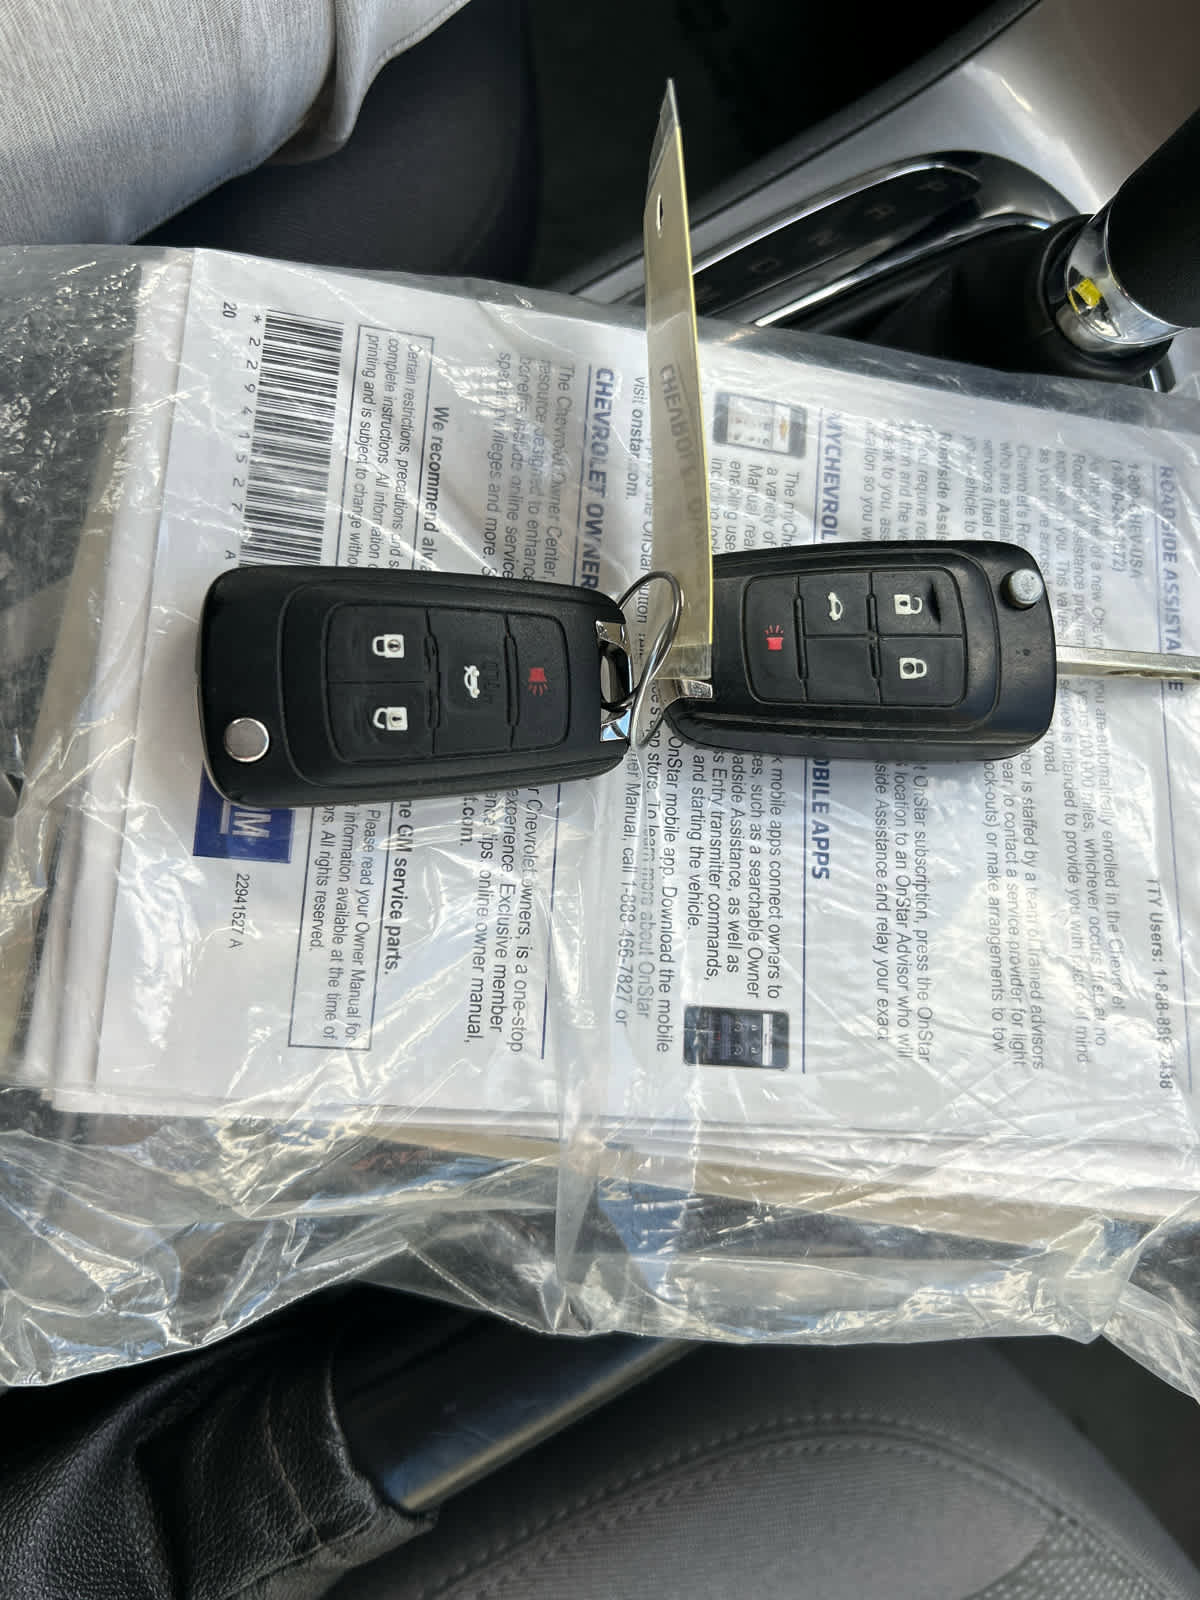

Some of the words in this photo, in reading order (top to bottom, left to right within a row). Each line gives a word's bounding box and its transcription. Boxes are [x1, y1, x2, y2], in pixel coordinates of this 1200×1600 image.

[222, 301, 237, 318] 20
[363, 334, 379, 378] printing
[384, 338, 399, 393] complete
[558, 363, 575, 391] The
[362, 381, 375, 404] and
[633, 377, 645, 404] visit
[361, 408, 373, 417] is
[398, 387, 415, 455] restrictions,
[432, 406, 449, 431] We
[588, 368, 614, 497] CHEVROLET
[355, 421, 369, 464] subject
[355, 468, 367, 479] to
[376, 472, 389, 488] All
[391, 459, 409, 530] precautions
[423, 436, 444, 531] recommend
[785, 471, 799, 497] The
[349, 483, 368, 528] change
[487, 483, 501, 512] and
[528, 501, 540, 515] to
[898, 502, 912, 522] the
[1159, 466, 1178, 563] ROADSIDE
[368, 491, 386, 558] information
[482, 517, 497, 559] more.
[764, 531, 776, 545] of
[1161, 568, 1184, 691] ASSISTAE
[646, 753, 661, 793] store.
[667, 736, 684, 787] OnStar
[692, 756, 707, 782] and
[1044, 741, 1059, 775] road.
[709, 768, 726, 806] Entry
[749, 785, 764, 818] such
[769, 768, 784, 816] mobile
[895, 771, 909, 826] location
[913, 776, 928, 826] OnStar
[1021, 782, 1034, 792] is
[363, 810, 380, 852] Please
[621, 783, 641, 841] Manual,
[647, 802, 661, 820] To
[664, 794, 681, 842] mobile
[686, 787, 706, 840] starting
[750, 823, 762, 840] as
[1022, 798, 1036, 845] staffed
[1065, 813, 1078, 826] to
[320, 831, 335, 846] All
[339, 812, 360, 882] information
[395, 824, 412, 852] GM
[689, 846, 703, 868] the
[709, 810, 724, 889] transmitter
[727, 808, 745, 891] Assistance,
[749, 845, 760, 854] a
[767, 820, 782, 855] apps
[811, 820, 830, 879] APPS
[875, 800, 890, 878] Assistance
[895, 832, 909, 846] to
[986, 833, 999, 847] or
[1004, 813, 1018, 863] contact
[315, 851, 334, 886] rights
[360, 856, 376, 885] read
[622, 848, 638, 873] call
[661, 848, 676, 881] app.
[895, 851, 909, 869] an
[912, 831, 930, 923] subscription,
[987, 851, 1001, 892] make
[1006, 868, 1017, 877] a
[1022, 851, 1038, 868] by
[1077, 839, 1099, 911] whichever
[1101, 831, 1119, 887] enrolled
[232, 872, 250, 935] 22941527
[356, 889, 372, 919] your
[389, 858, 408, 919] service
[477, 870, 493, 916] online
[687, 874, 703, 930] vehicle.
[728, 897, 741, 914] as
[747, 860, 762, 941] searchable
[767, 860, 782, 920] connect
[876, 883, 891, 911] and
[895, 875, 910, 928] OnStar
[1006, 883, 1022, 935] service
[1105, 893, 1118, 905] in
[311, 891, 327, 950] reserved.
[332, 887, 351, 944] available
[496, 883, 516, 958] Exclusive
[638, 911, 655, 956] about
[659, 886, 678, 963] Download
[727, 920, 741, 950] well
[872, 917, 891, 952] relay
[1106, 911, 1120, 932] the
[230, 938, 242, 949] A
[331, 949, 344, 964] at
[351, 922, 370, 965] Owner
[384, 926, 400, 975] parts.
[472, 922, 488, 972] owner
[517, 946, 532, 959] is
[615, 881, 637, 1002] 1-888-466-7827
[705, 894, 722, 981] commands,
[767, 924, 782, 979] owners
[915, 929, 931, 971] press
[986, 897, 1006, 1001] arrangements
[1062, 830, 1079, 884] provide
[1076, 1026, 1090, 1062] mind
[1150, 912, 1164, 963] Users:
[328, 968, 344, 988] the
[515, 964, 529, 974] a
[659, 969, 675, 993] the
[726, 955, 740, 973] as
[746, 947, 763, 998] Owner
[873, 959, 890, 993] your
[897, 933, 912, 990] Advisor
[1008, 940, 1025, 1001] provider
[325, 993, 341, 1021] time
[347, 969, 366, 1018] Manual
[490, 964, 508, 1032] member
[637, 961, 654, 1018] OnStar
[768, 984, 781, 999] to
[917, 977, 930, 1000] the
[346, 1023, 360, 1040] for
[464, 978, 484, 1043] manual,
[510, 980, 529, 1052] one-stop
[615, 1009, 629, 1027] or
[655, 999, 673, 1052] mobile
[877, 998, 893, 1041] exact
[898, 996, 912, 1027] who
[992, 1007, 1006, 1021] to
[1011, 1007, 1025, 1027] for
[323, 1026, 338, 1039] of
[918, 1007, 933, 1064] OnStar
[992, 1027, 1006, 1052] tow
[1010, 1033, 1028, 1066] light
[1029, 1005, 1046, 1069] advisors
